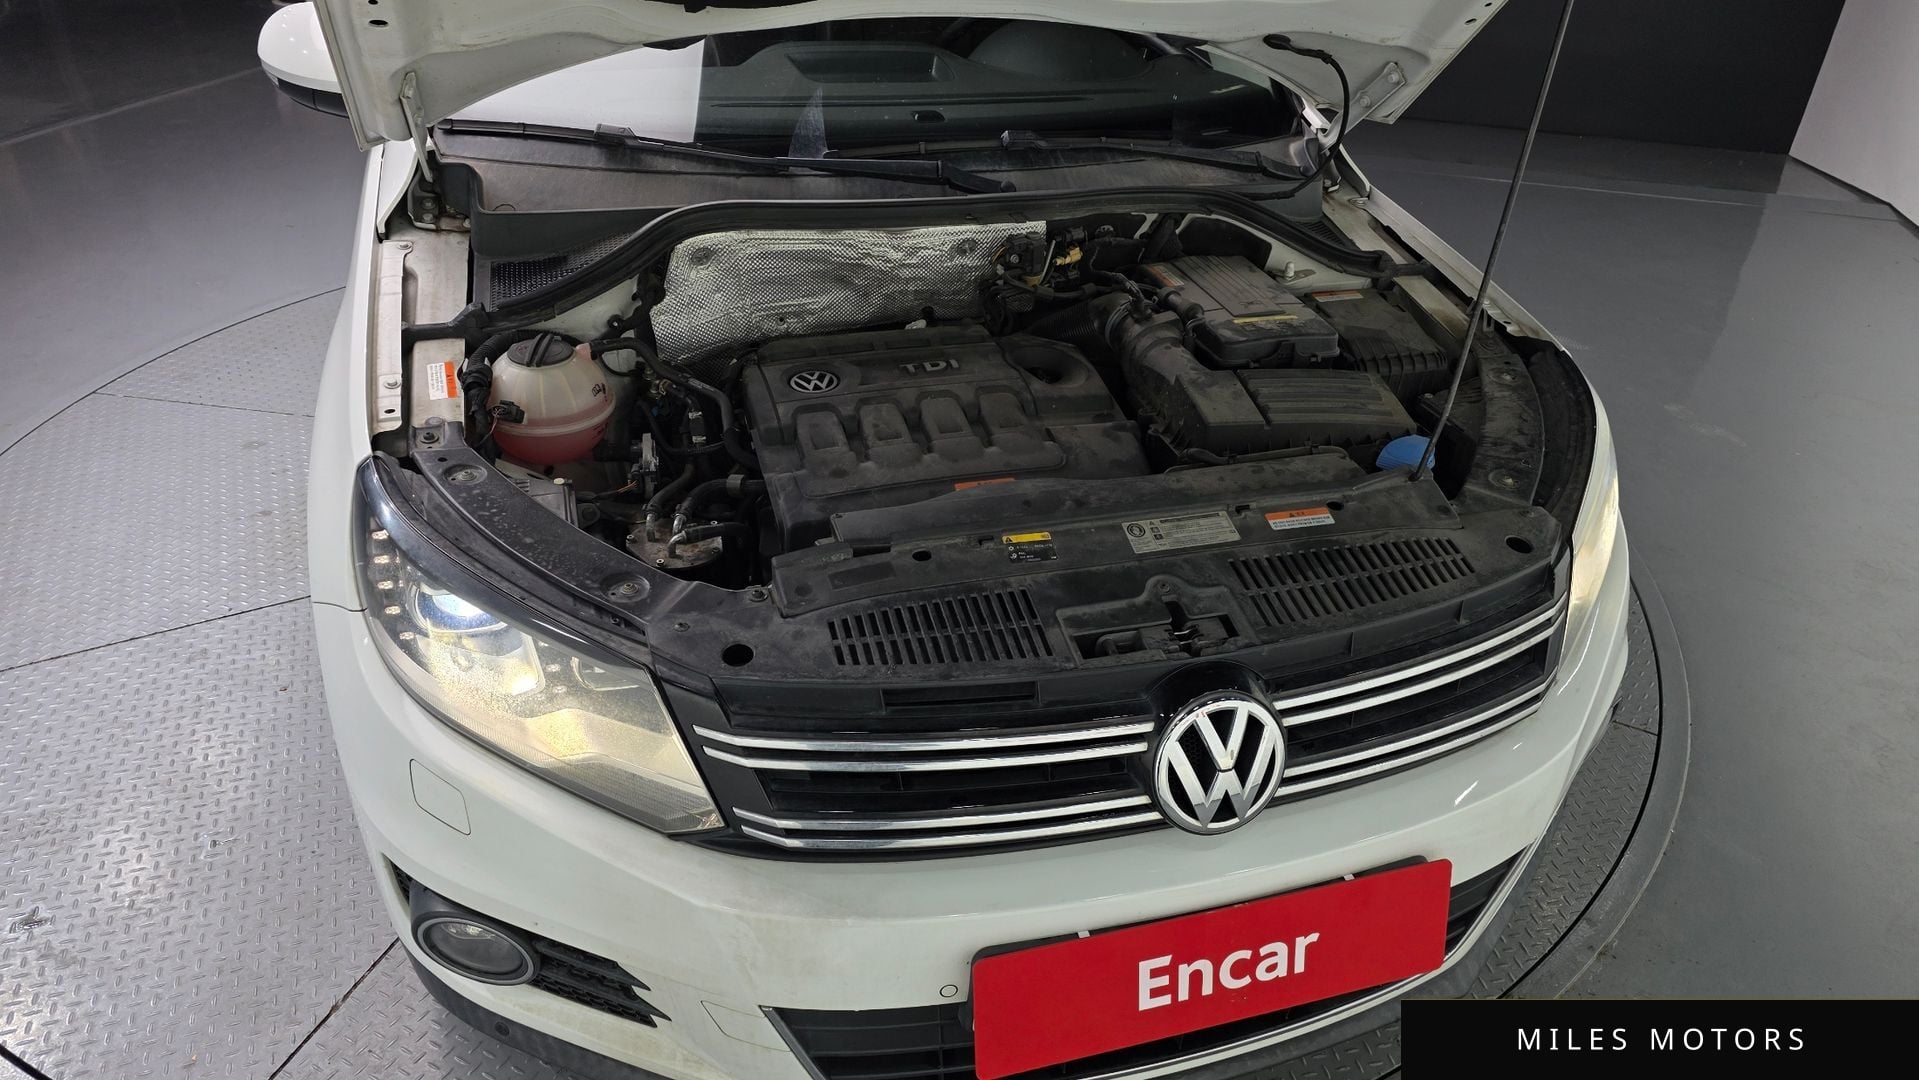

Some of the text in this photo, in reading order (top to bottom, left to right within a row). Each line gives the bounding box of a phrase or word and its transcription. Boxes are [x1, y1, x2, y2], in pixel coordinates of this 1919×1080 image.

[789, 370, 839, 394] VW
[901, 359, 960, 374] TDI
[1155, 695, 1284, 834] VW
[1138, 932, 1320, 1012] Encar
